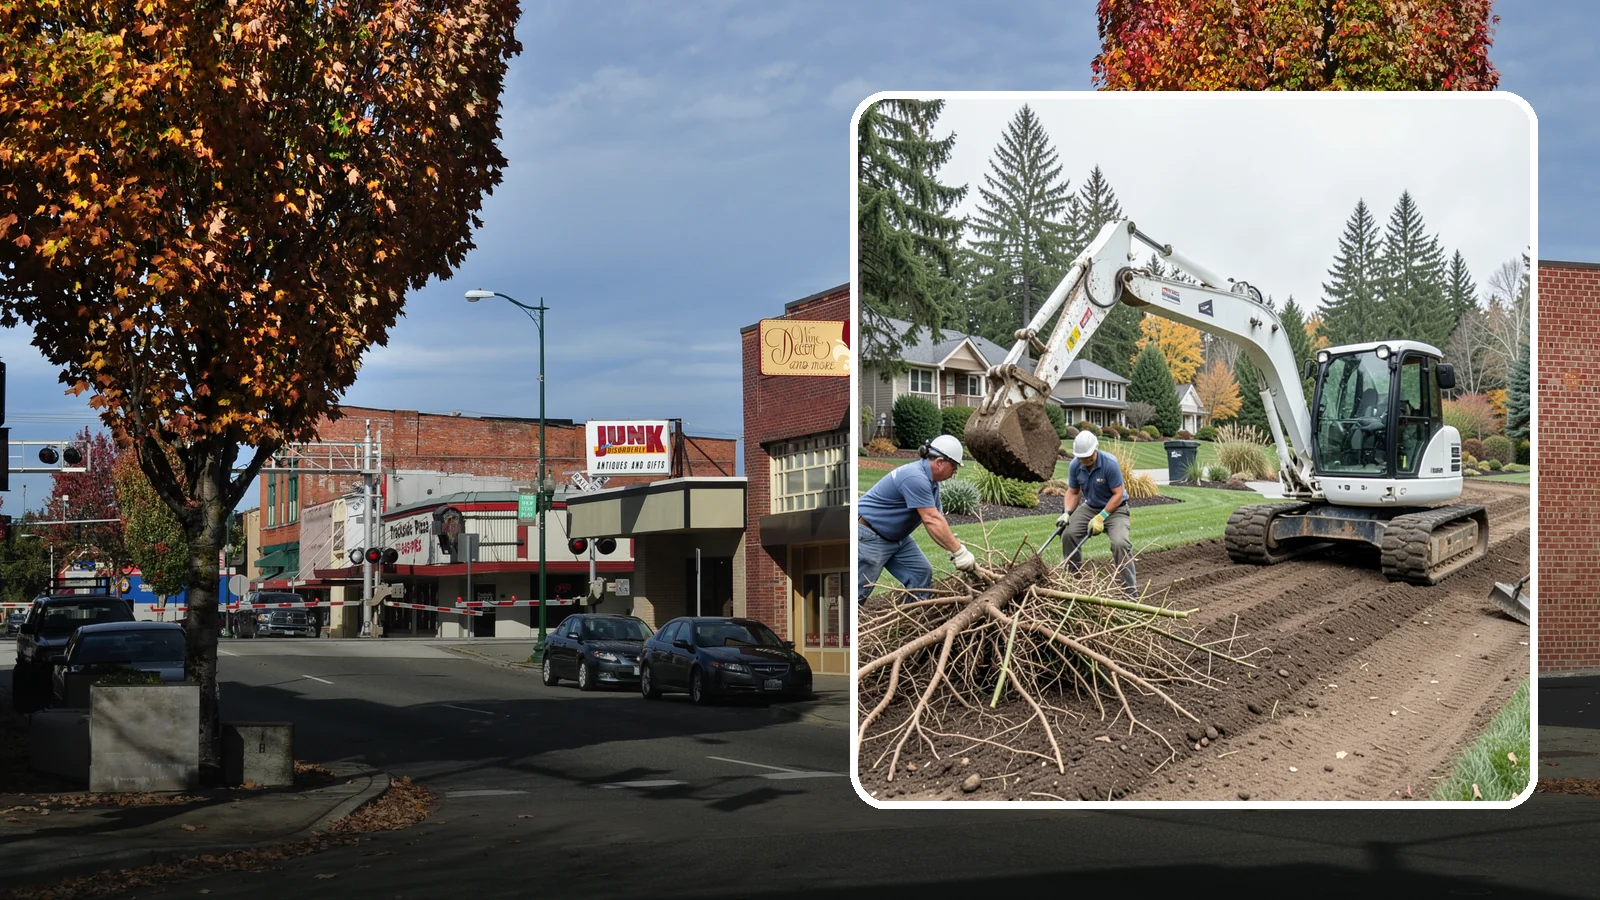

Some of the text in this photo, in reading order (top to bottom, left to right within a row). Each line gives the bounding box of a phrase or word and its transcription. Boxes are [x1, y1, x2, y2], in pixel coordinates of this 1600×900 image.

[764, 327, 831, 366] Decor
[595, 425, 664, 457] JUNK
[607, 446, 646, 454] DISORDERLY
[596, 460, 665, 470] ANTIQUES AND GIFTS
[414, 519, 429, 535] Pizza
